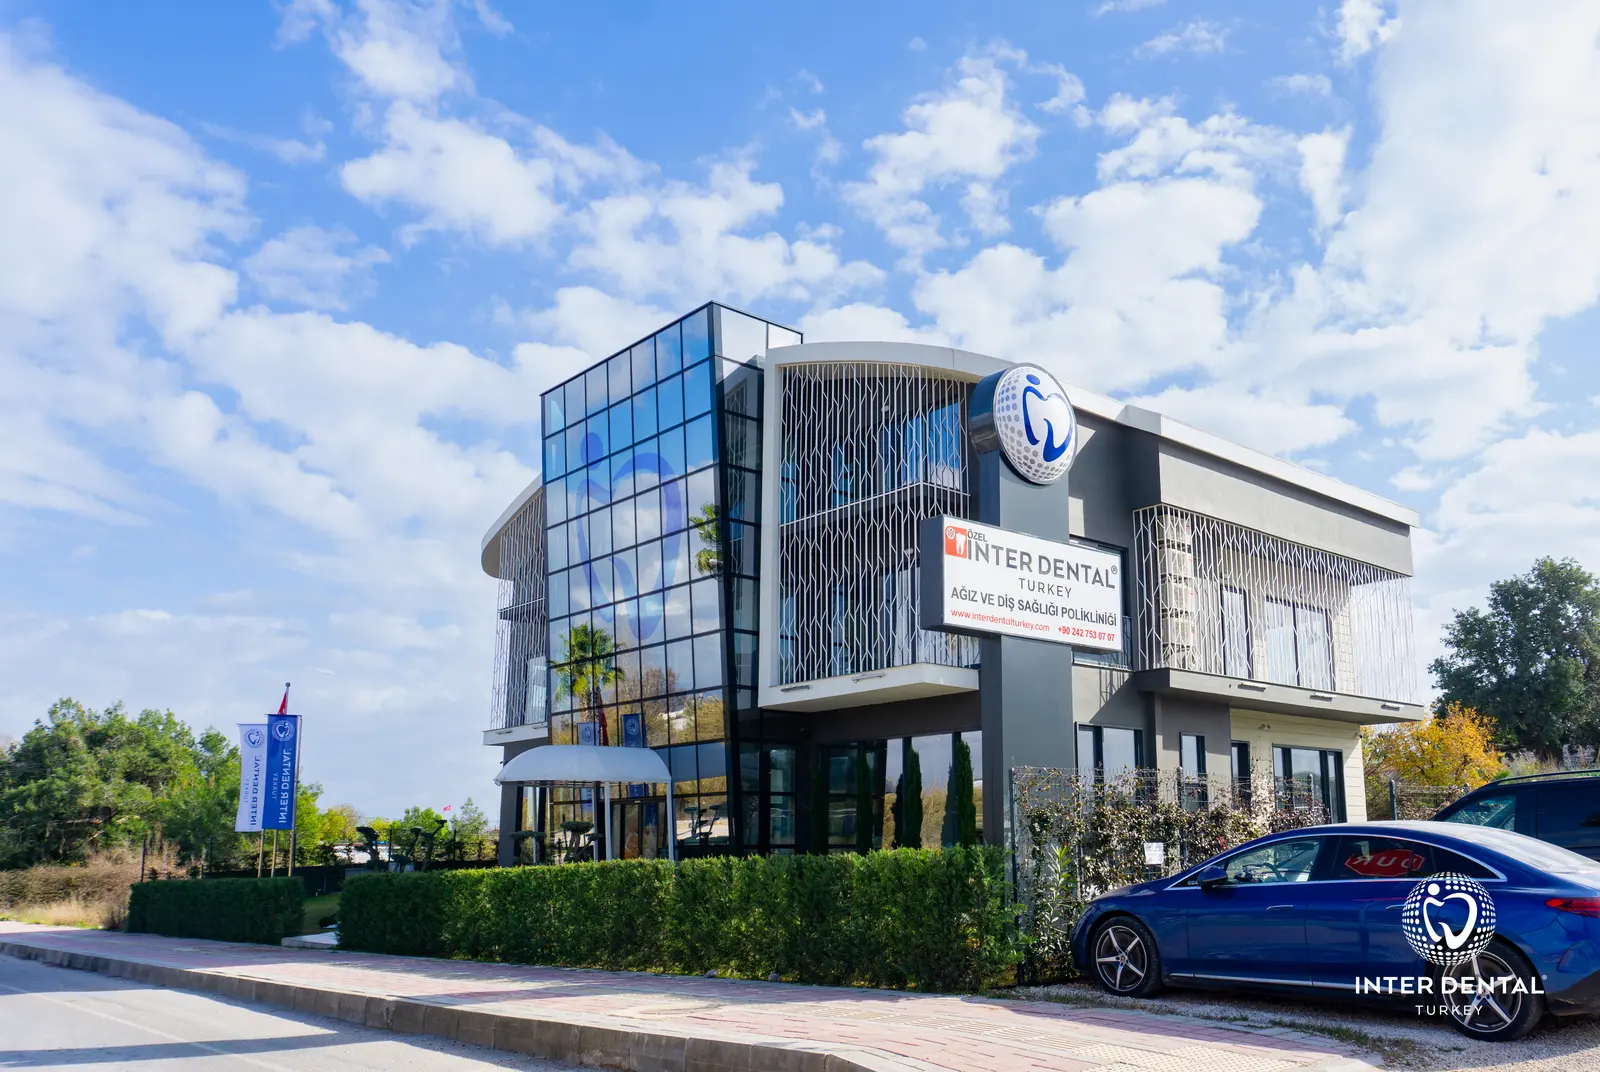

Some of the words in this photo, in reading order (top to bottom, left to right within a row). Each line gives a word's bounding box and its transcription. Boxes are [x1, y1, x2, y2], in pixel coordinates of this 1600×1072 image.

[967, 529, 988, 543] ÖZEL
[967, 540, 1033, 573] INTER
[1018, 577, 1072, 598] TURKEY
[951, 585, 978, 603] AĞIZ
[980, 592, 995, 606] VE
[997, 594, 1015, 612] DİŞ
[1017, 599, 1059, 617] SAĞLIĞI
[1061, 606, 1117, 626] POLİKLİNİĞİ
[951, 609, 1050, 632] www.interdentalturkey.com
[1058, 625, 1071, 635] +90
[1072, 627, 1084, 637] 242
[1085, 629, 1097, 640] 753
[1098, 632, 1106, 641] 07
[1107, 633, 1115, 642] 07
